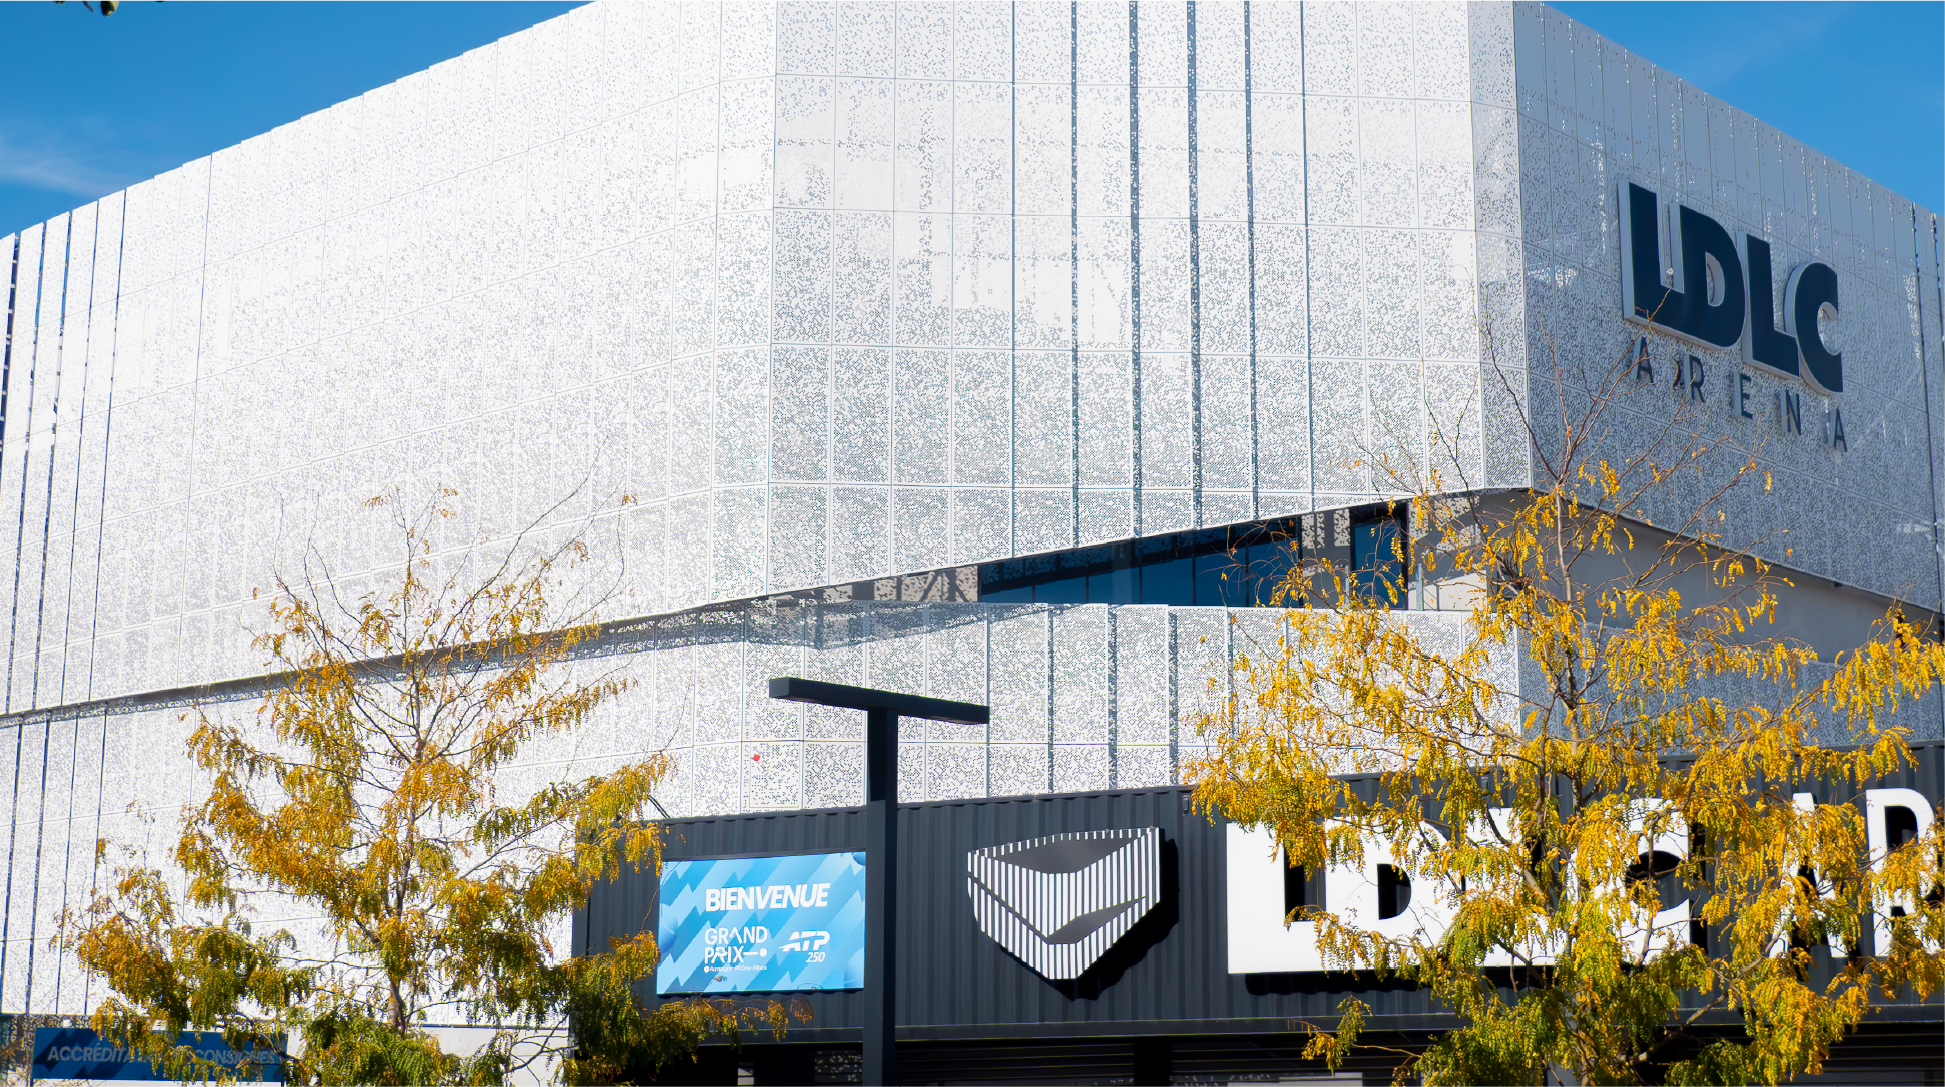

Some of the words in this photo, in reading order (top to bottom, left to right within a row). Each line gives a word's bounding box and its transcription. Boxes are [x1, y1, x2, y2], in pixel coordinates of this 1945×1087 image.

[1618, 181, 1844, 394] LDLC
[1631, 336, 1848, 452] ARENA
[705, 882, 831, 912] BIENVENUE
[704, 926, 768, 945] GRAND
[778, 930, 831, 952] ATP
[704, 946, 745, 964] PRIX
[805, 952, 826, 963] 250
